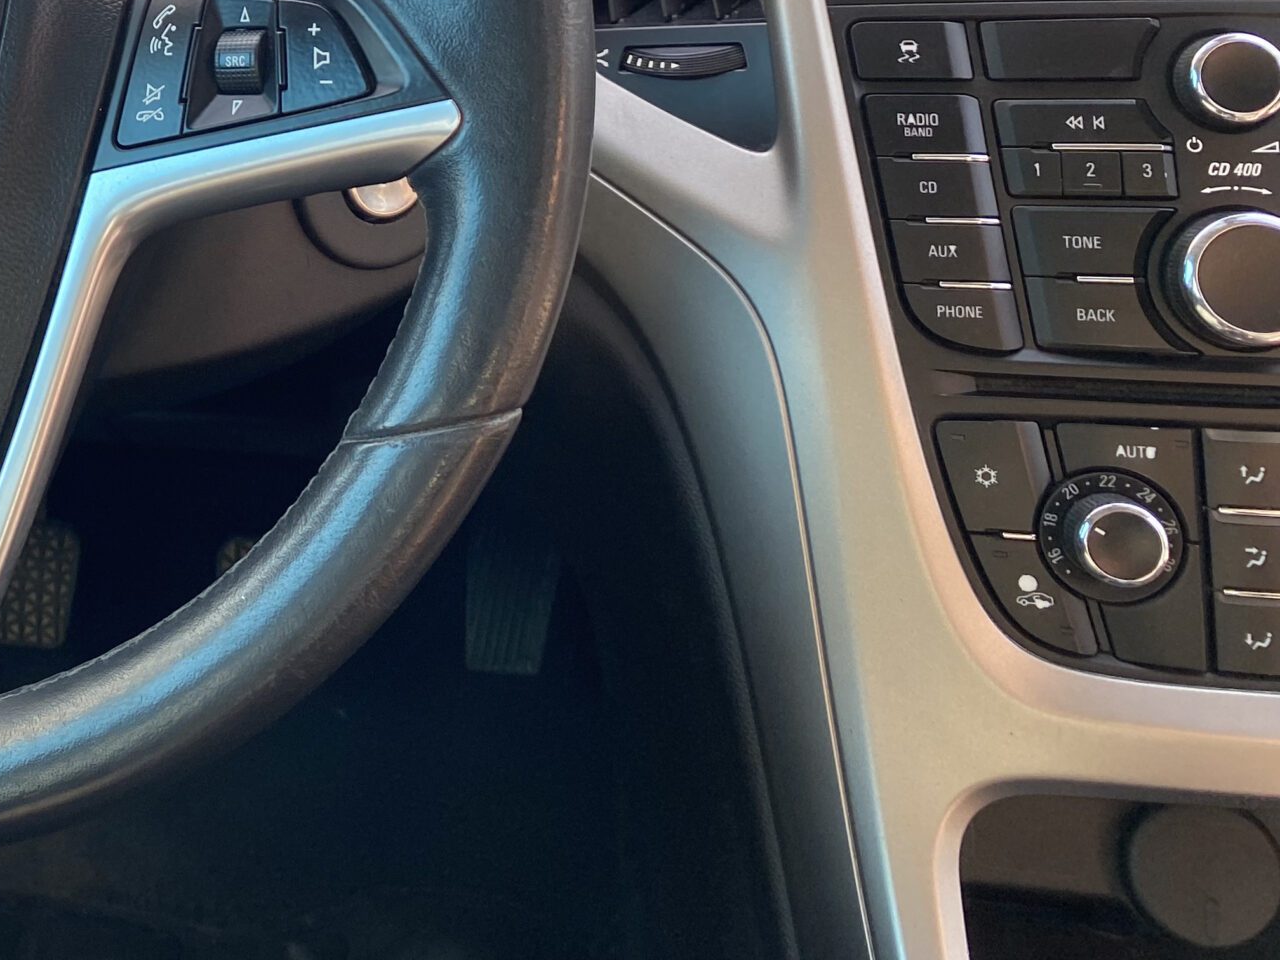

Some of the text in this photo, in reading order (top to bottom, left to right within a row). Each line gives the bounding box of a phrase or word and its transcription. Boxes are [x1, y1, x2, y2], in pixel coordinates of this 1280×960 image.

[224, 55, 246, 67] SRC
[897, 112, 939, 127] RADIO
[904, 127, 933, 138] BAND
[1034, 162, 1040, 177] 1
[1085, 162, 1097, 177] 2
[1141, 163, 1153, 178] 3
[1208, 162, 1262, 177] CD 400
[919, 180, 938, 194] CD
[1063, 235, 1102, 250] TONE
[928, 244, 958, 258] AUX
[937, 305, 984, 319] PHONE
[1076, 308, 1116, 322] BACK
[1099, 475, 1116, 488] 22
[1062, 483, 1079, 500] 20
[1136, 487, 1157, 503] 24
[1043, 513, 1058, 527] 18
[1048, 547, 1064, 564] 16
